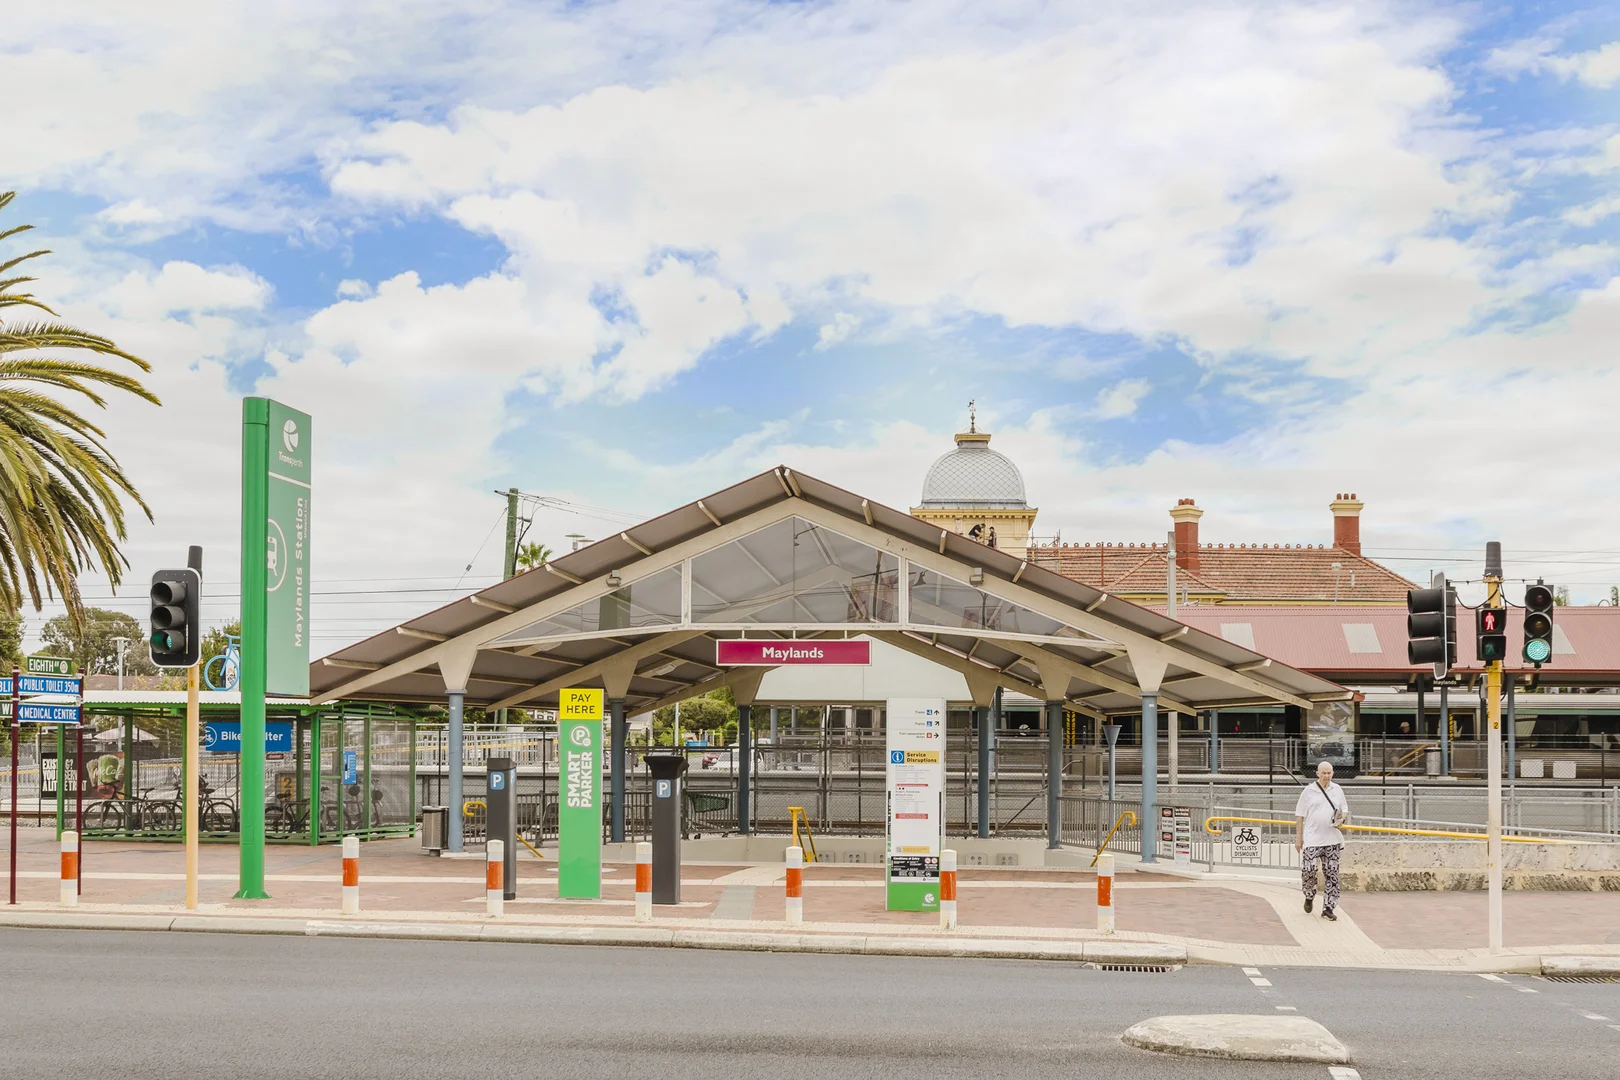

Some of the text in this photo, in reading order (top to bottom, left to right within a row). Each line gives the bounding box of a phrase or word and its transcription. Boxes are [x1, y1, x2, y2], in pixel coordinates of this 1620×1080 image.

[295, 498, 303, 648] Maylands Station
[762, 647, 824, 661] Maylands
[29, 659, 54, 672] EIGHTH
[24, 679, 79, 693] PUBLIC TOILET 350m
[571, 694, 591, 702] PAY
[25, 707, 77, 720] MEDICAL CENTRE
[567, 705, 595, 714] HERE
[221, 731, 242, 741] Bike
[493, 774, 502, 788] P
[568, 751, 580, 807] SMART
[581, 751, 592, 808] PARKER
[659, 782, 668, 795] P
